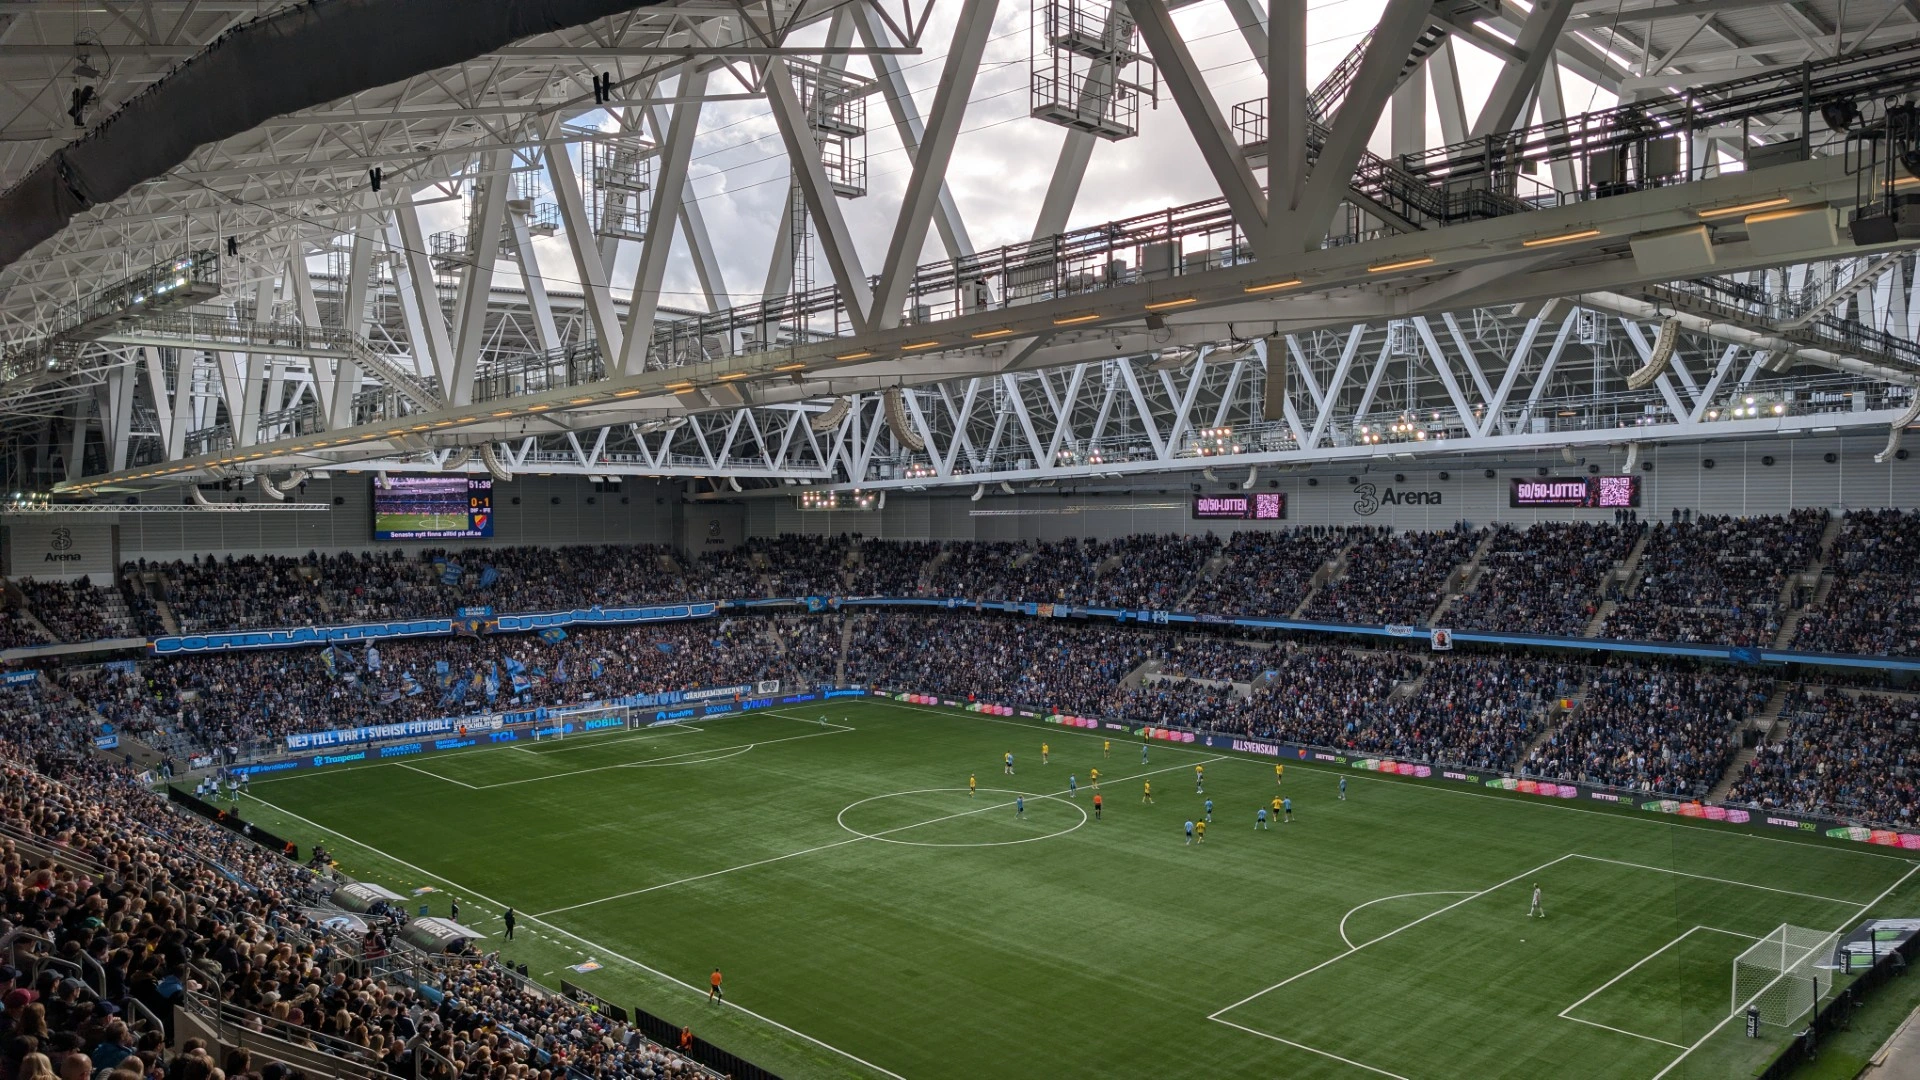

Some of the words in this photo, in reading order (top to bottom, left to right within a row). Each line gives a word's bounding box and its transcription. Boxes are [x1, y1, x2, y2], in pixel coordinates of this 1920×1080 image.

[1381, 487, 1442, 505] Arena
[1518, 482, 1586, 499] 50/50-LOTTEN
[471, 497, 477, 507] 0
[1198, 497, 1247, 512] 50/50-LOTTEN
[44, 552, 82, 562] Arena
[668, 709, 694, 719] NordVPN
[585, 717, 623, 731] MOBILL
[287, 735, 309, 748] NEJ
[311, 733, 335, 746] TILL
[337, 730, 358, 742] VAR
[361, 729, 366, 739] I
[368, 725, 407, 738] SVENSK
[409, 718, 451, 734] FOTBOLL
[489, 729, 518, 743] TCL
[1232, 739, 1279, 756] ALLSVENSKAN
[1315, 753, 1335, 762] BETTER
[261, 762, 298, 772] Ventilation
[1443, 771, 1466, 780] BETTER
[1592, 792, 1619, 802] BETTER
[1619, 796, 1634, 804] YOU
[1767, 817, 1799, 828] BETTER
[1799, 822, 1817, 831] YOU
[343, 883, 384, 901] UNIBET
[413, 918, 460, 939] UNIBET
[1747, 1015, 1755, 1038] SELECT
